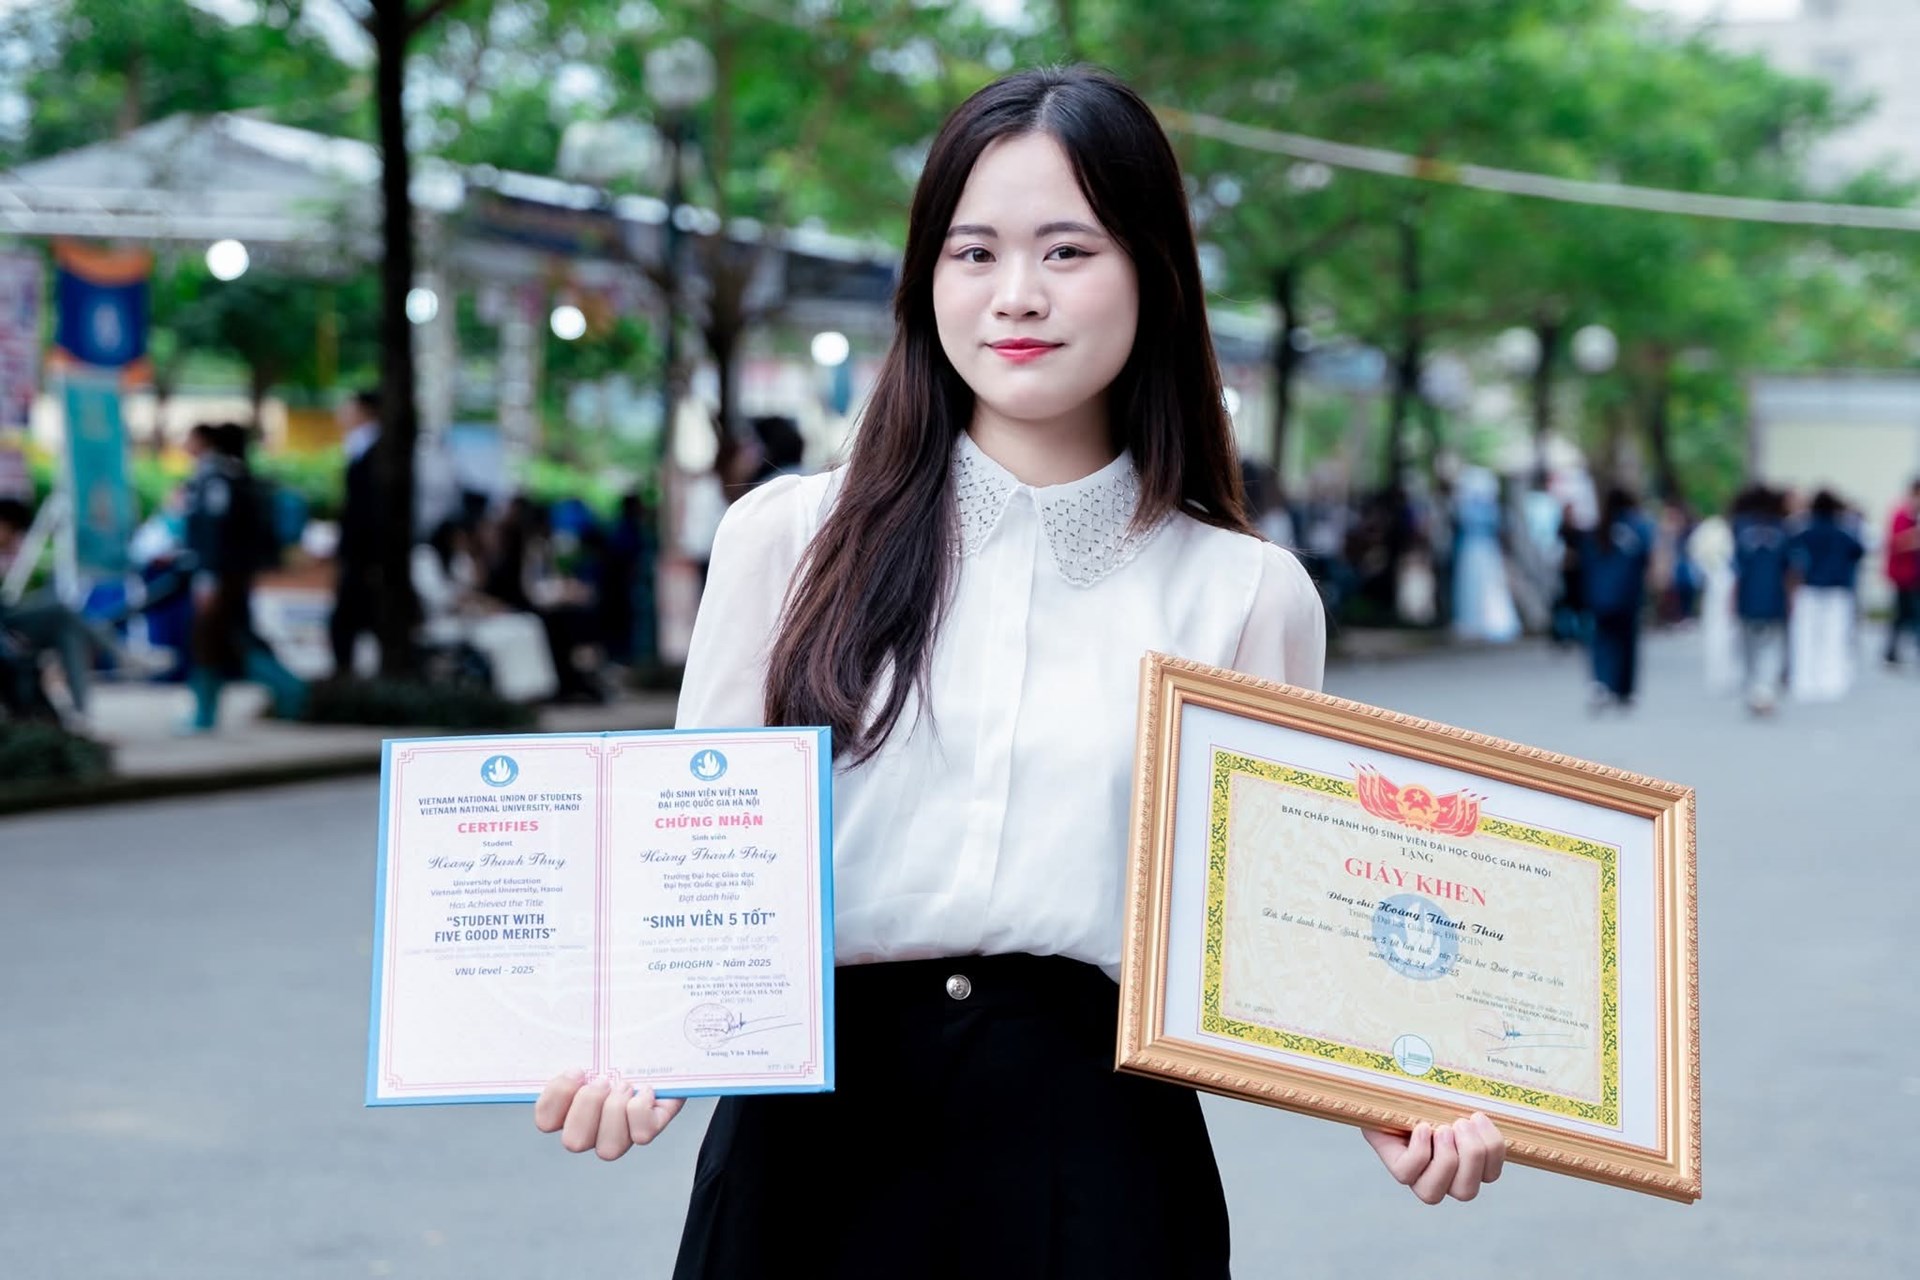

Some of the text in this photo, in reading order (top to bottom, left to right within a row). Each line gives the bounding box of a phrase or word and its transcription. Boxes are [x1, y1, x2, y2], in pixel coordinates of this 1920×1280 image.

[418, 793, 582, 806] VIETNAM NATIONAL UNION OF STUDENTS
[660, 789, 674, 800] HỘI
[676, 790, 696, 798] SINH
[698, 788, 716, 798] VIÊN
[739, 788, 758, 796] NAM
[716, 799, 730, 807] GIA
[420, 804, 580, 816] VIETNAM NATIONAL UNIVERSITY, HANOI
[458, 820, 539, 834] CERTIFIES
[655, 812, 764, 830] CHỨNG NHẬN
[1282, 804, 1302, 816] BAN
[1382, 830, 1404, 841] SINH
[1500, 858, 1516, 869] GIA
[691, 847, 736, 862] Thanh
[428, 852, 566, 872] Hoang Thanh Thuy
[453, 880, 492, 888] University
[504, 878, 541, 886] Education
[1344, 856, 1486, 906] GIẤY KHEN
[430, 888, 462, 896] Vietnam
[464, 887, 496, 896] National
[449, 899, 544, 910] Has Achieved the Title
[513, 914, 544, 925] WITH
[690, 910, 724, 926] VIÊN
[729, 912, 738, 926] 5
[1378, 901, 1421, 921] Hoàng
[1426, 912, 1466, 932] Thanh
[434, 930, 461, 942] FIVE
[466, 930, 498, 941] GOOD
[670, 960, 713, 970] ĐHQGHN
[748, 958, 772, 968] 2025
[454, 967, 476, 976] VNU
[478, 966, 502, 975] level
[511, 966, 534, 974] 2025
